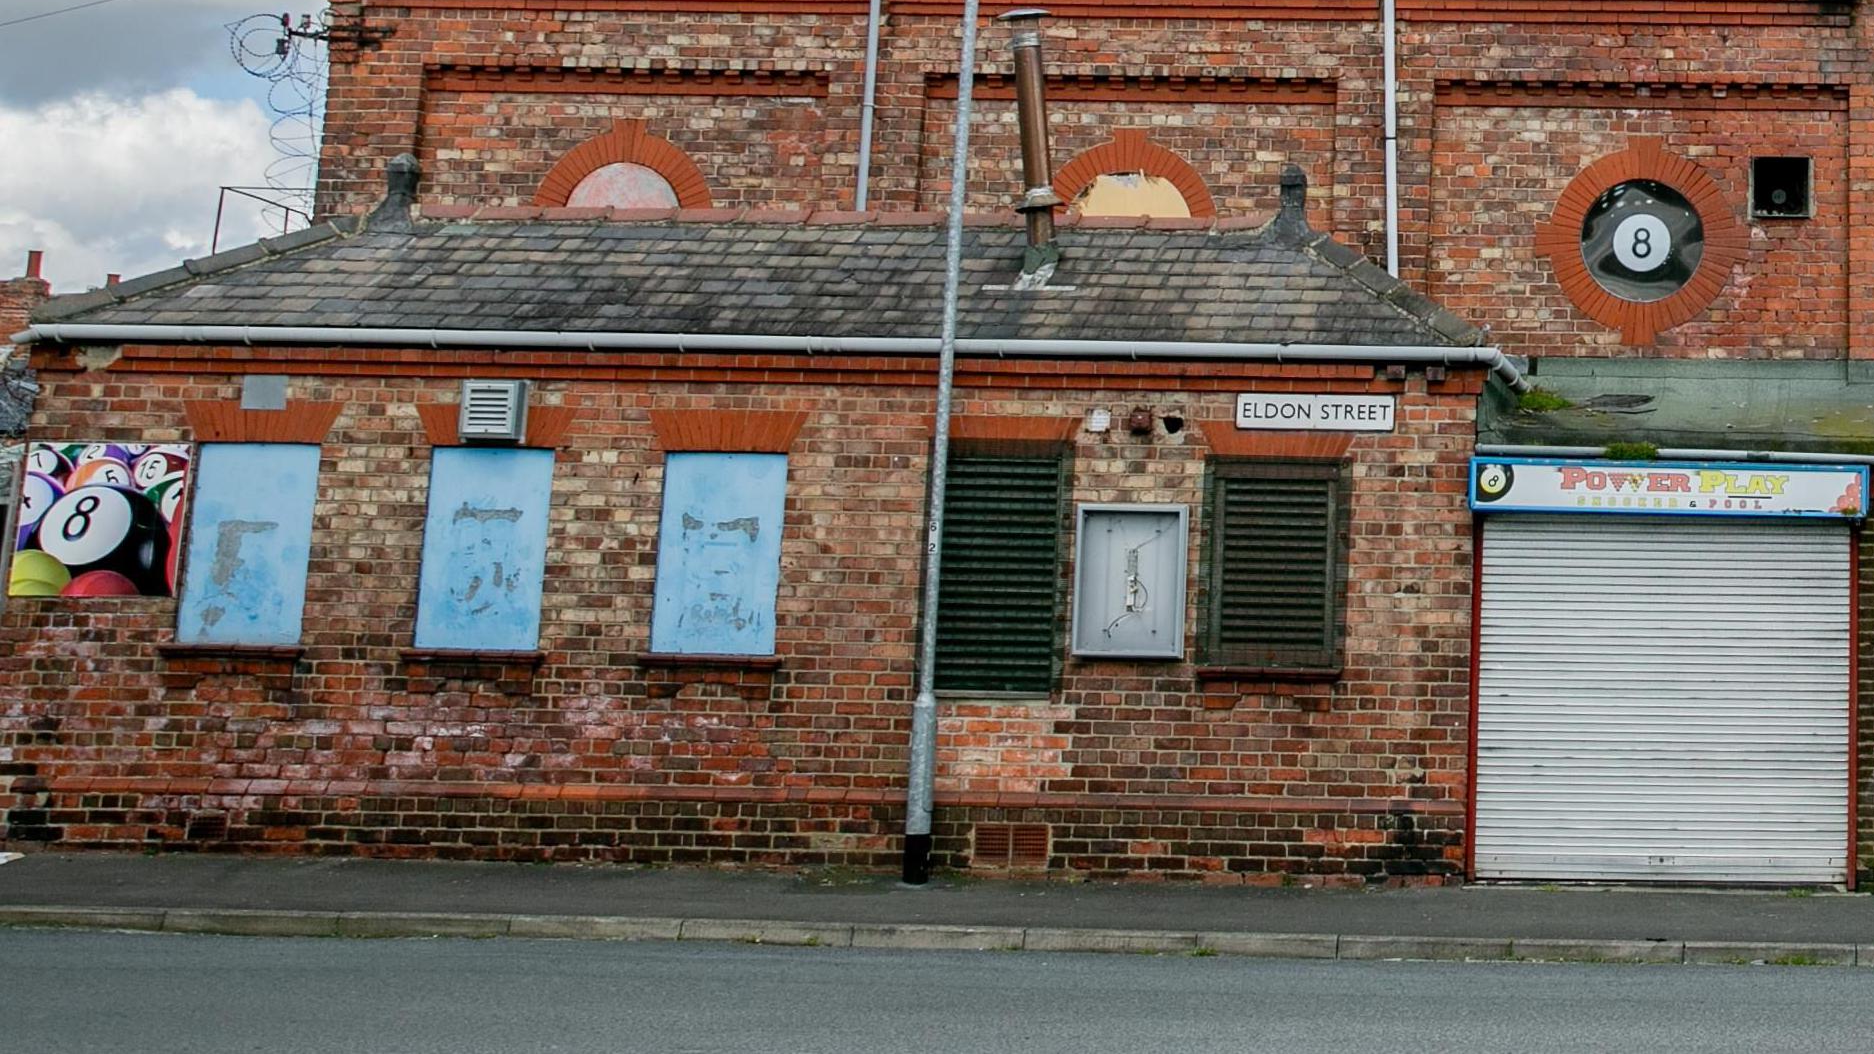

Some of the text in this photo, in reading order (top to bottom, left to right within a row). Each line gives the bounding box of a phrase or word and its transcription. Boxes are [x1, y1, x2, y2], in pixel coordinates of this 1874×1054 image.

[1632, 228, 1651, 258] 8
[1243, 403, 1391, 420] ELDON STREET
[140, 460, 161, 480] 15
[1488, 475, 1499, 487] 8
[1698, 470, 1789, 494] PLAY
[1689, 500, 1697, 508] &
[1708, 498, 1762, 509] POOL
[62, 496, 100, 542] 8
